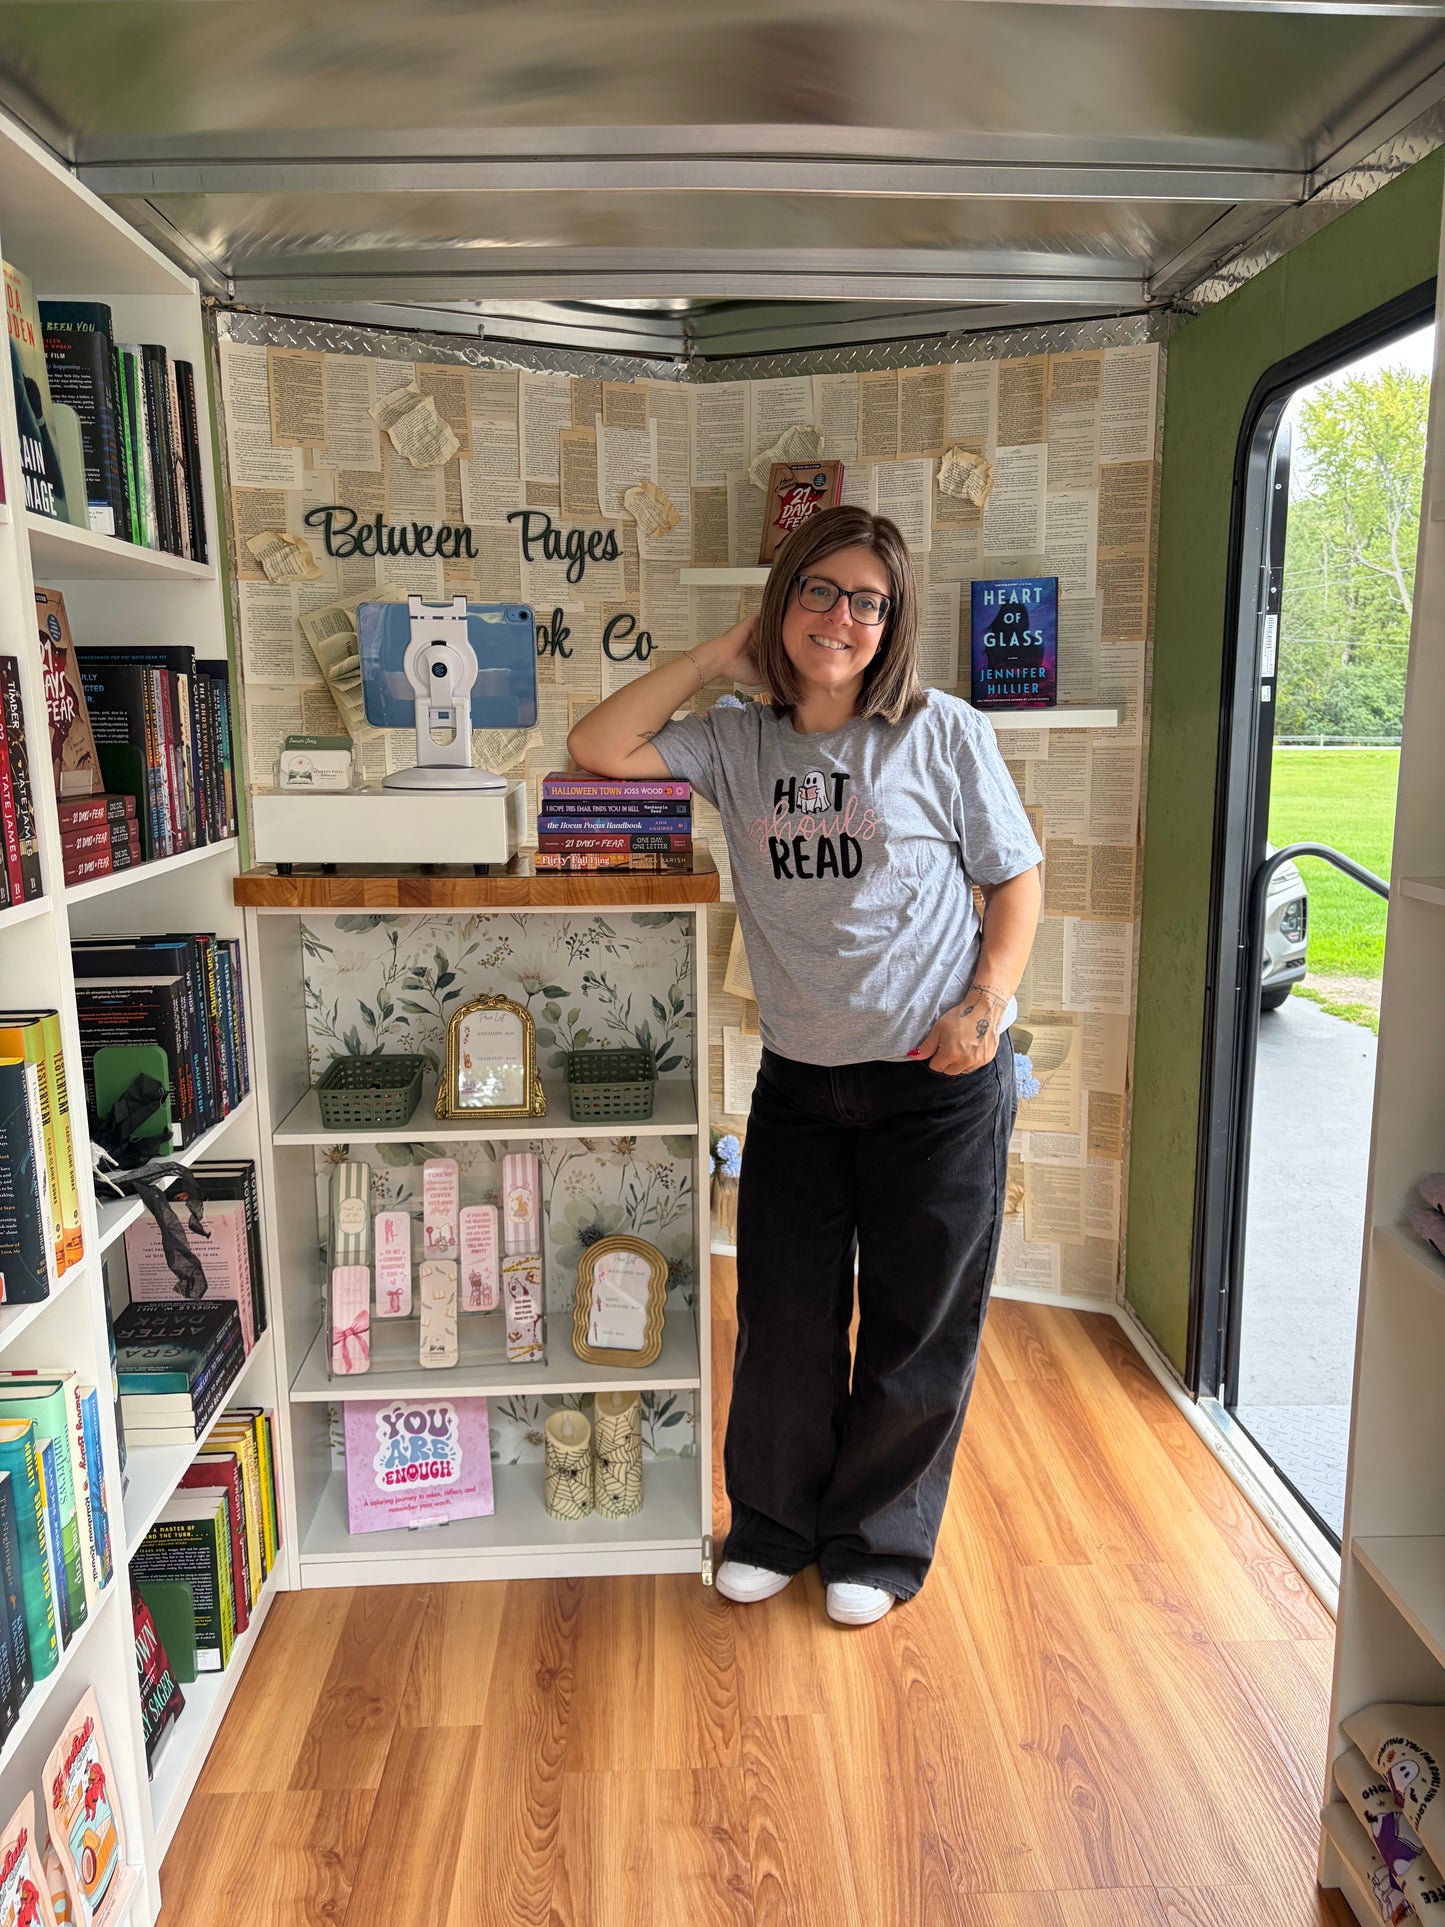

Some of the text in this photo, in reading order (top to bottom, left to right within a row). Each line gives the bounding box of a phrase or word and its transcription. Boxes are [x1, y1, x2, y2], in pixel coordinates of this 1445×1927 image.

[77, 321, 95, 333] YOU
[50, 352, 66, 360] FILM
[191, 404, 199, 446] STRANGER
[782, 501, 817, 519] DAYS
[790, 486, 812, 506] 21
[304, 505, 624, 585] Between Pages
[983, 587, 1043, 606] HEART
[1003, 612, 1021, 624] OF
[603, 613, 659, 662] Co
[983, 629, 1043, 647] GLASS
[980, 667, 1046, 682] JENNIFER
[987, 683, 1039, 695] HILLIER
[8, 681, 20, 730] TIMBER
[47, 695, 76, 724] FEAR
[200, 703, 210, 770] GHOSTWRITER
[18, 770, 33, 857] TATE JAMES
[91, 807, 104, 820] FEAR
[150, 788, 159, 838] GOLDBERG
[158, 788, 166, 837] GOLDBERG
[198, 787, 206, 829] JACKSON
[545, 805, 640, 813] I HOPE THIS EMAIL FINDS YOU IN HELL
[551, 786, 663, 796] HALLOWEEN TOWN JOSS WOOD
[2, 773, 18, 862] TATE JAMES
[95, 832, 108, 844] FEAR
[583, 822, 606, 830] Pocus
[606, 821, 643, 829] Handbook
[747, 795, 884, 853] ghouls
[97, 856, 110, 869] FEAR
[541, 855, 610, 866] Flirty Fall Fling
[565, 839, 625, 848] 21 DAYS FEAR
[768, 832, 863, 880] READ
[186, 970, 192, 986] WE
[208, 971, 218, 1017] GARDNER
[199, 1002, 208, 1049] BEFORE
[20, 1069, 29, 1118] EVERYTHING
[37, 1060, 51, 1127] YESTERYEAR
[53, 1049, 69, 1116] YESTERYEAR
[193, 1053, 204, 1113] SLAUGHTER
[243, 1180, 252, 1231] ROBERTS
[251, 1172, 259, 1222] ROBERTS
[117, 1326, 205, 1338] AFTER
[132, 1314, 206, 1326] DARK
[125, 1348, 181, 1358] GRA
[193, 1382, 203, 1399] NONE
[202, 1371, 211, 1385] LEFT
[216, 1352, 224, 1365] TELL
[73, 1385, 86, 1470] Cherry Baby
[196, 1414, 208, 1433] ROOM
[213, 1387, 224, 1404] RENT
[382, 1407, 449, 1440] YOU
[24, 1441, 35, 1489] MORIARTY
[54, 1435, 68, 1505] andrews
[384, 1460, 452, 1485] ENOUGH
[385, 1435, 449, 1469] ARE
[233, 1466, 241, 1521] HEPWORTH
[370, 1498, 395, 1507] coloring
[395, 1495, 418, 1504] journey
[425, 1491, 443, 1499] relax,
[444, 1488, 464, 1496] reflect,
[464, 1486, 476, 1494] and
[388, 1500, 454, 1513] remember your worth.
[2, 1521, 14, 1586] Nightingale
[34, 1491, 55, 1630] SUNLIGHT FINDS YOU
[53, 1521, 62, 1565] PARRISH
[71, 1521, 83, 1584] road trip
[85, 1496, 98, 1583] Rainbow Rowell
[135, 1618, 158, 1674] OWN
[149, 1670, 175, 1723] SAGER
[1405, 1739, 1438, 1803] YOU FOR AND
